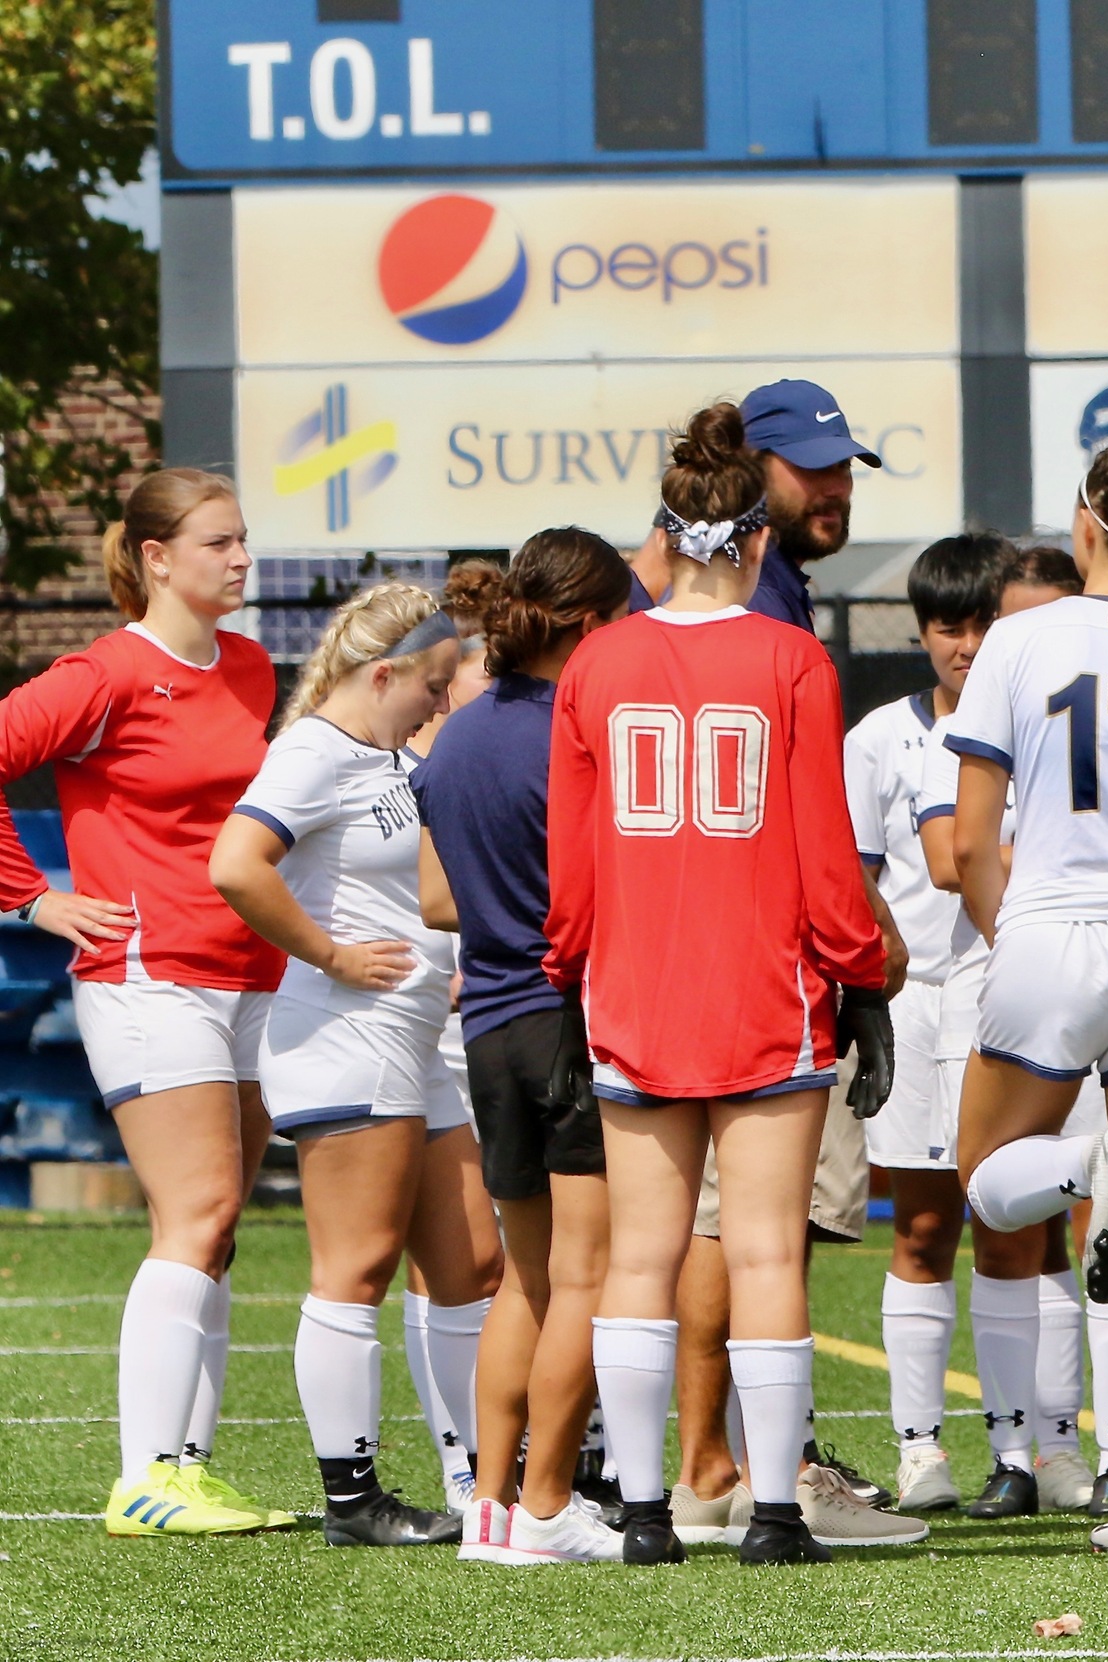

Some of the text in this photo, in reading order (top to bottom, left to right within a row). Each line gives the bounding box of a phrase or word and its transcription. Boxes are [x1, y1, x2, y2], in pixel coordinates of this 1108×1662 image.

[228, 37, 491, 141] T.O.L.
[552, 228, 770, 305] pepsi
[607, 703, 771, 839] 00
